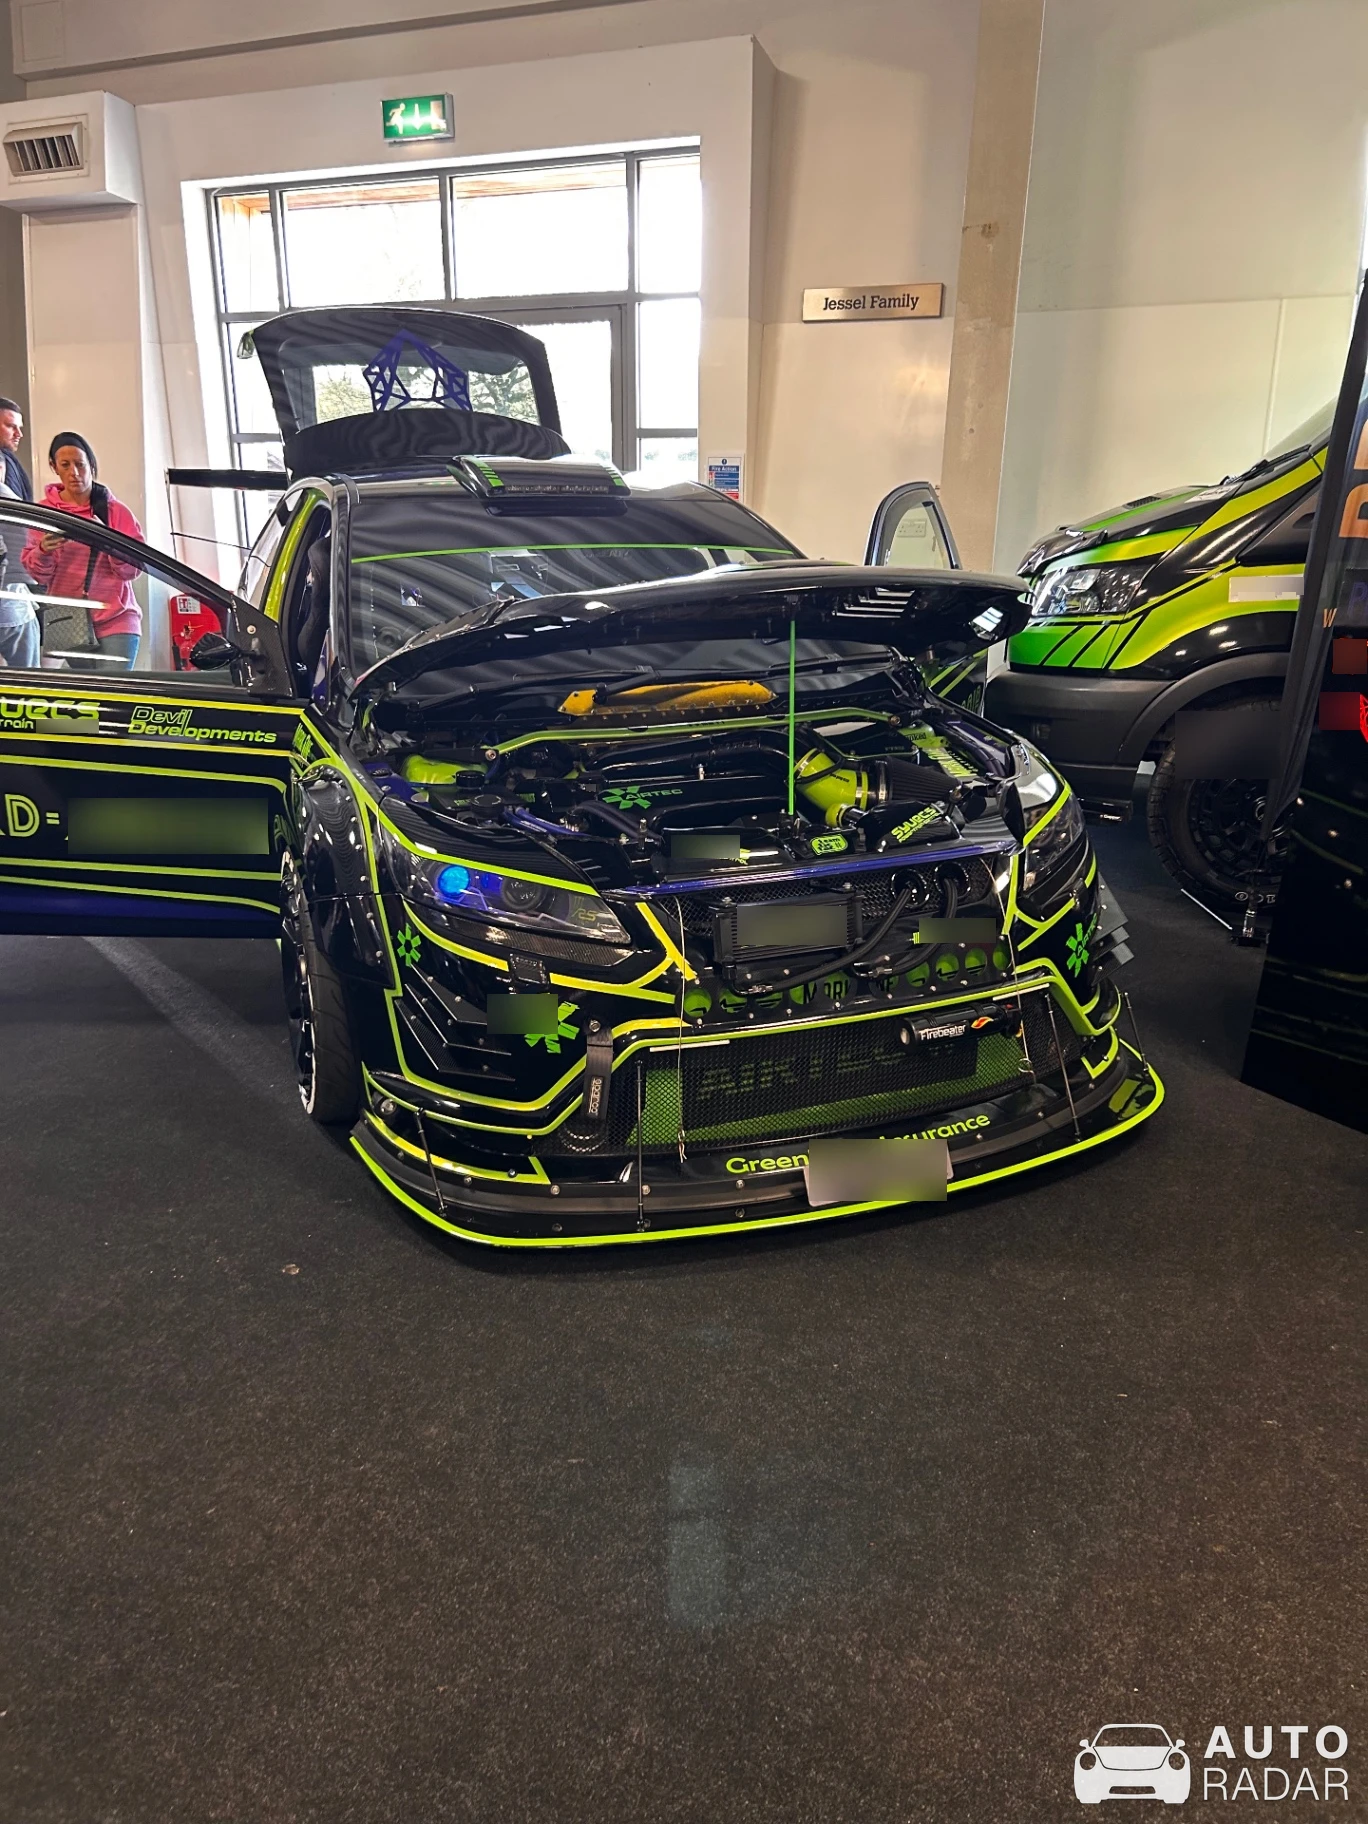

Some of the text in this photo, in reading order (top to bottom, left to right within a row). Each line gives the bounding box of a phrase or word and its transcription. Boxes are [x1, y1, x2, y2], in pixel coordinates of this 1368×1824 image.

[823, 293, 920, 311] Jessel Family
[131, 705, 193, 730] Devil
[127, 721, 278, 743] Developments
[625, 788, 684, 801] AIRTEC
[918, 1022, 967, 1041] Firebeater
[588, 1077, 603, 1116] sparco
[725, 1151, 809, 1174] Green
